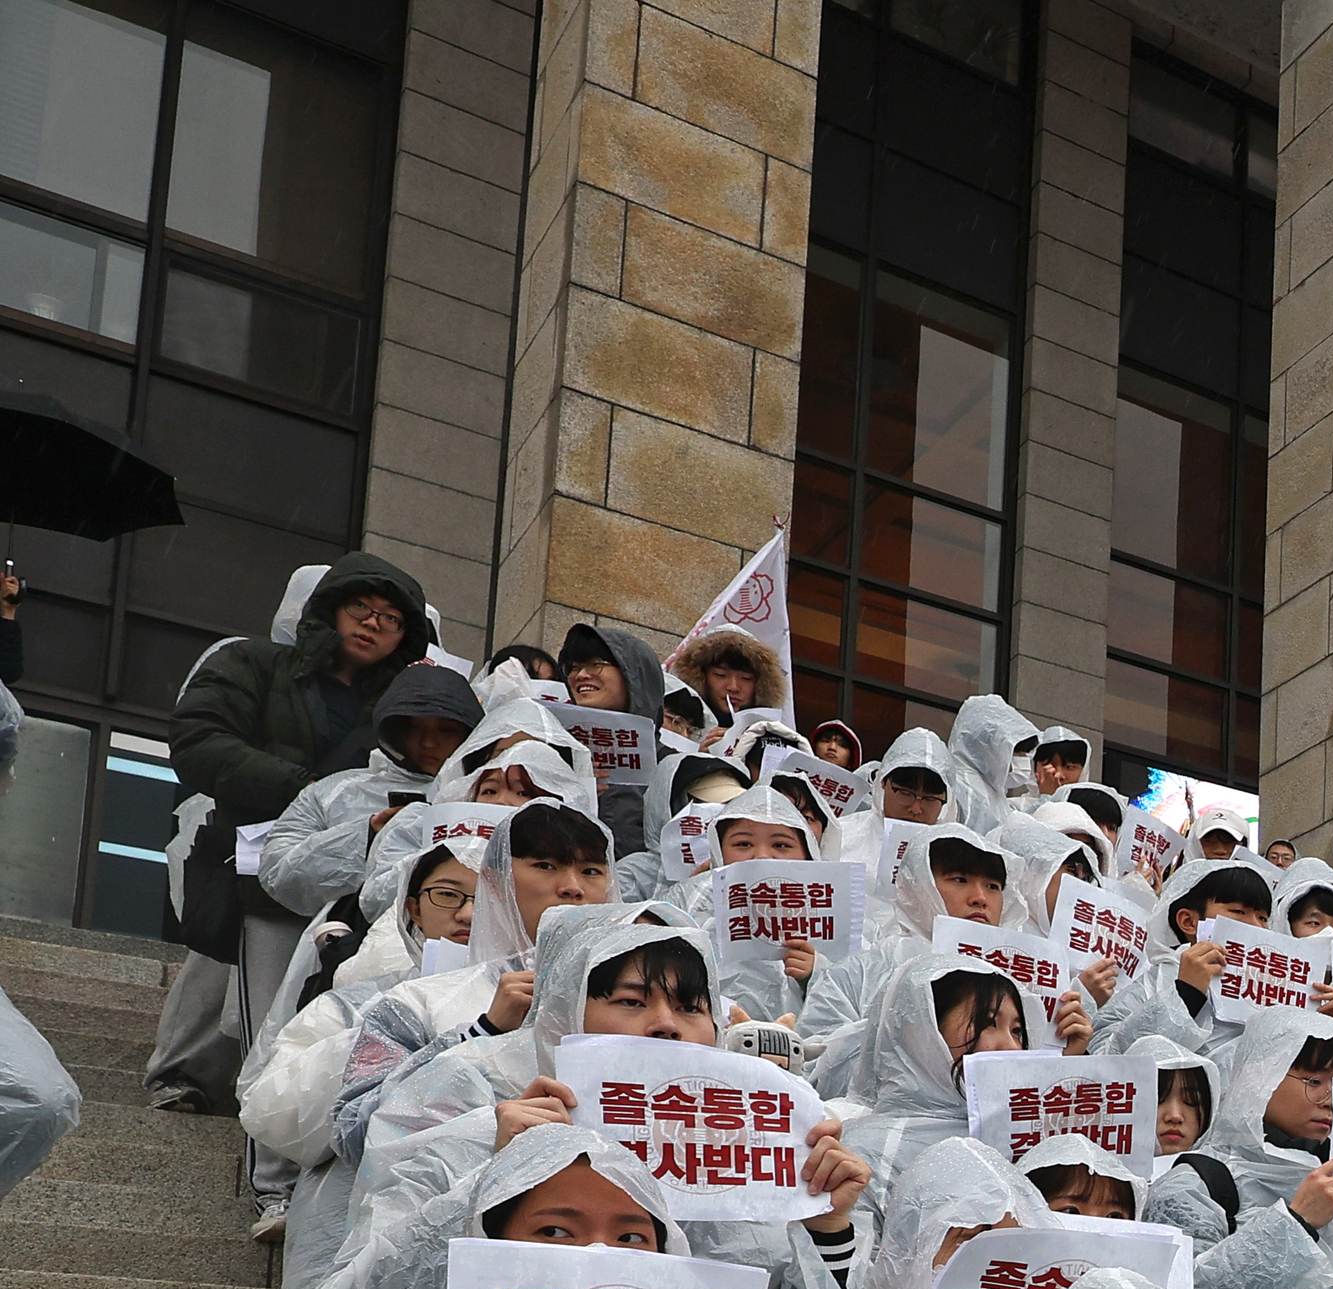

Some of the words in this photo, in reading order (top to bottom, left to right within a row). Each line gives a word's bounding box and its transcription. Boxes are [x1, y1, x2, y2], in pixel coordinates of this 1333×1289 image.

[568, 724, 640, 748] 속통합
[590, 751, 642, 771] 반대
[728, 883, 834, 909] 졸속통합
[728, 915, 834, 943] 결사반대
[1074, 898, 1148, 952] 졸속통합
[1069, 928, 1140, 979] 결사반대
[1224, 940, 1312, 985] 졸속통합
[1220, 973, 1307, 1009] 결사반대
[600, 1082, 794, 1133] 졸속통합
[1009, 1082, 1137, 1121] 졸속통합
